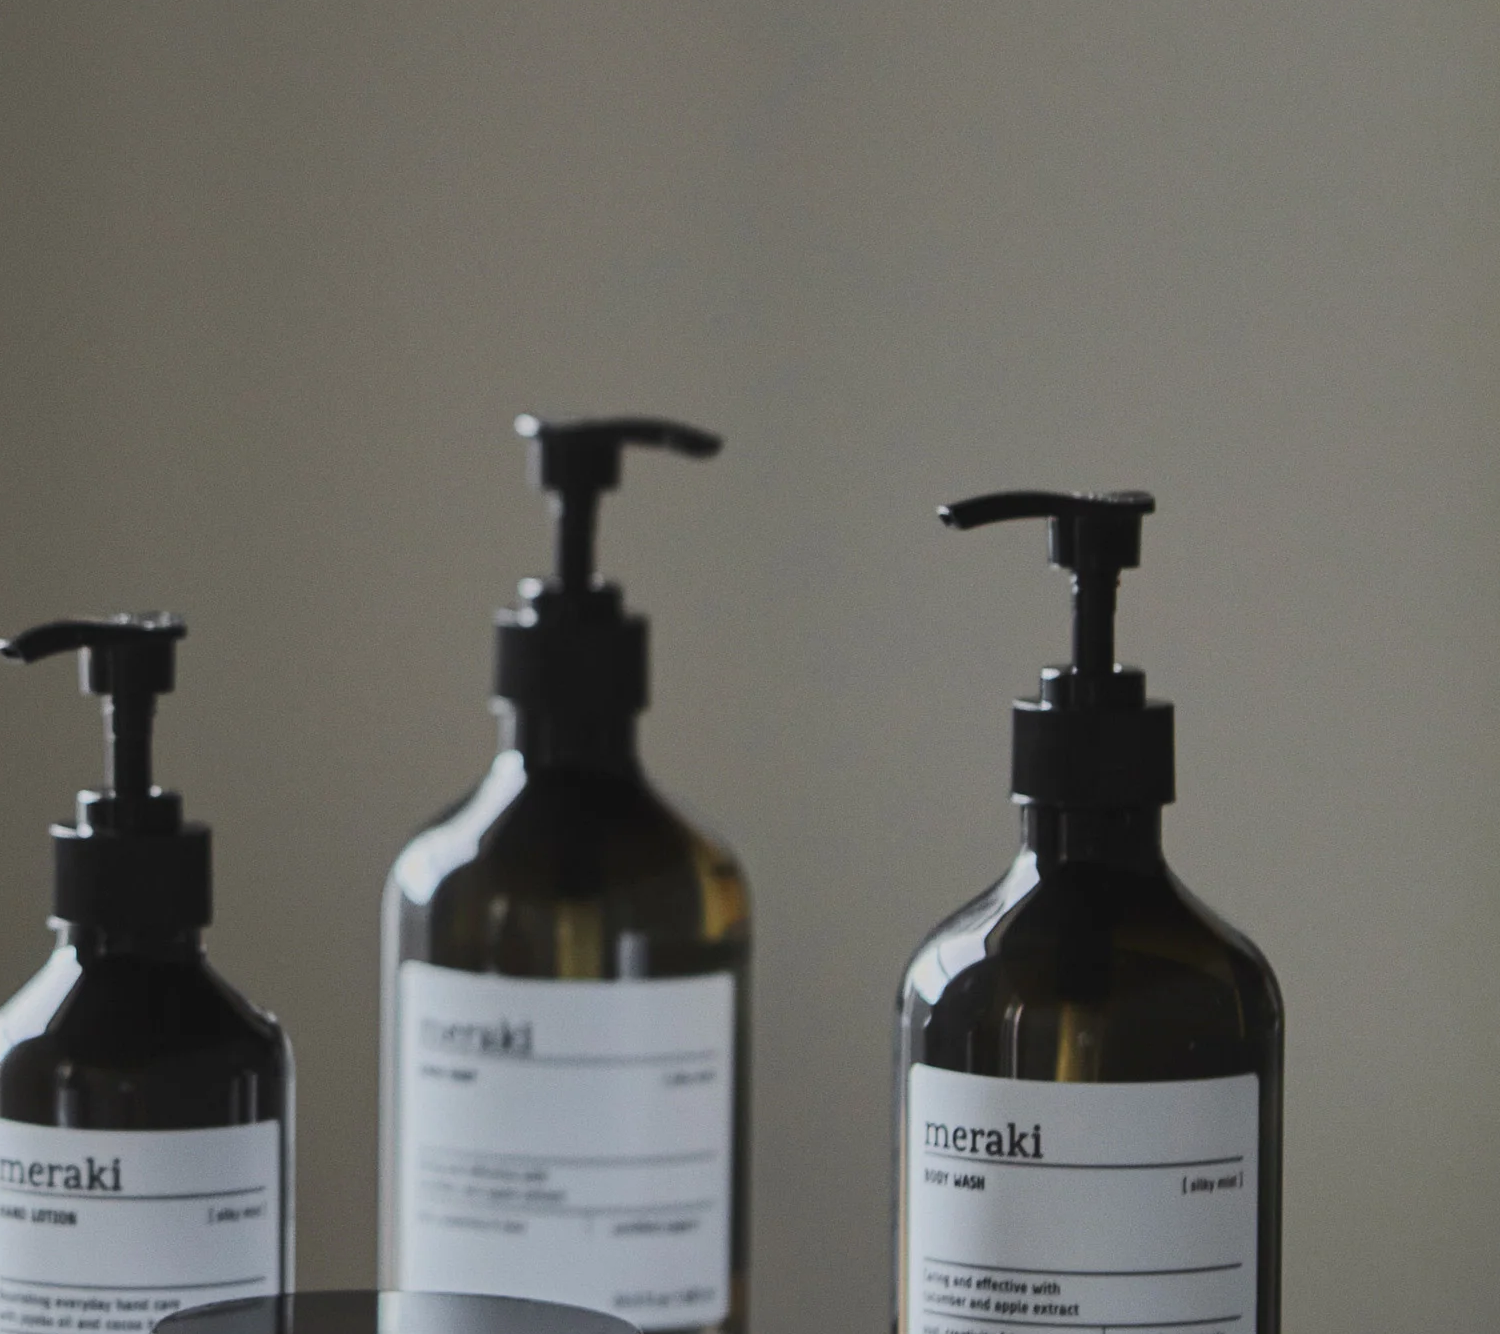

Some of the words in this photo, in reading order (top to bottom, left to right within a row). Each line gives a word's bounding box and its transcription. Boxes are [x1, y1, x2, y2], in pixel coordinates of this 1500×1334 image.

[925, 1122, 1043, 1159] meraki
[0, 1157, 121, 1191] meraki
[954, 1173, 985, 1190] WASH
[953, 1276, 972, 1289] and
[976, 1277, 1027, 1294] effective
[1032, 1281, 1061, 1295] with
[970, 1299, 991, 1311] and
[995, 1299, 1028, 1315] apple
[1033, 1303, 1079, 1316] extract
